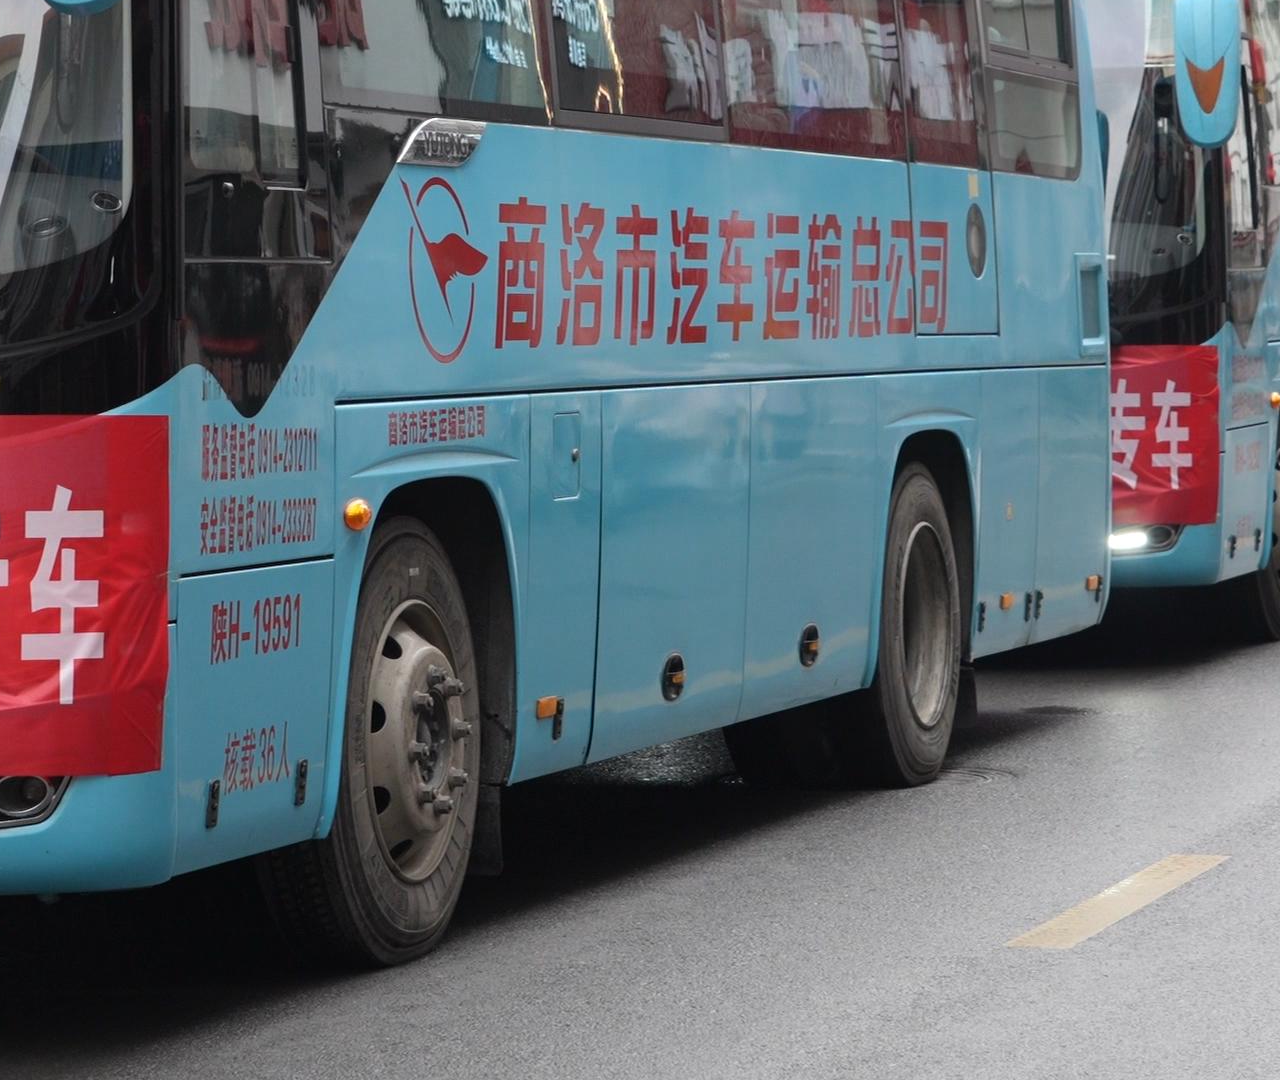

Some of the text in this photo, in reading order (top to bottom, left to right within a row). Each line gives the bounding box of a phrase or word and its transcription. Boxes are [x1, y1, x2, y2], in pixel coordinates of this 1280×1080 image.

[420, 130, 470, 156] YUTONG
[494, 196, 949, 349] 商洛市汽车运输总公司
[1111, 378, 1193, 491] 专车
[210, 593, 301, 665] 陕H-19591
[223, 721, 290, 796] 核载36人
